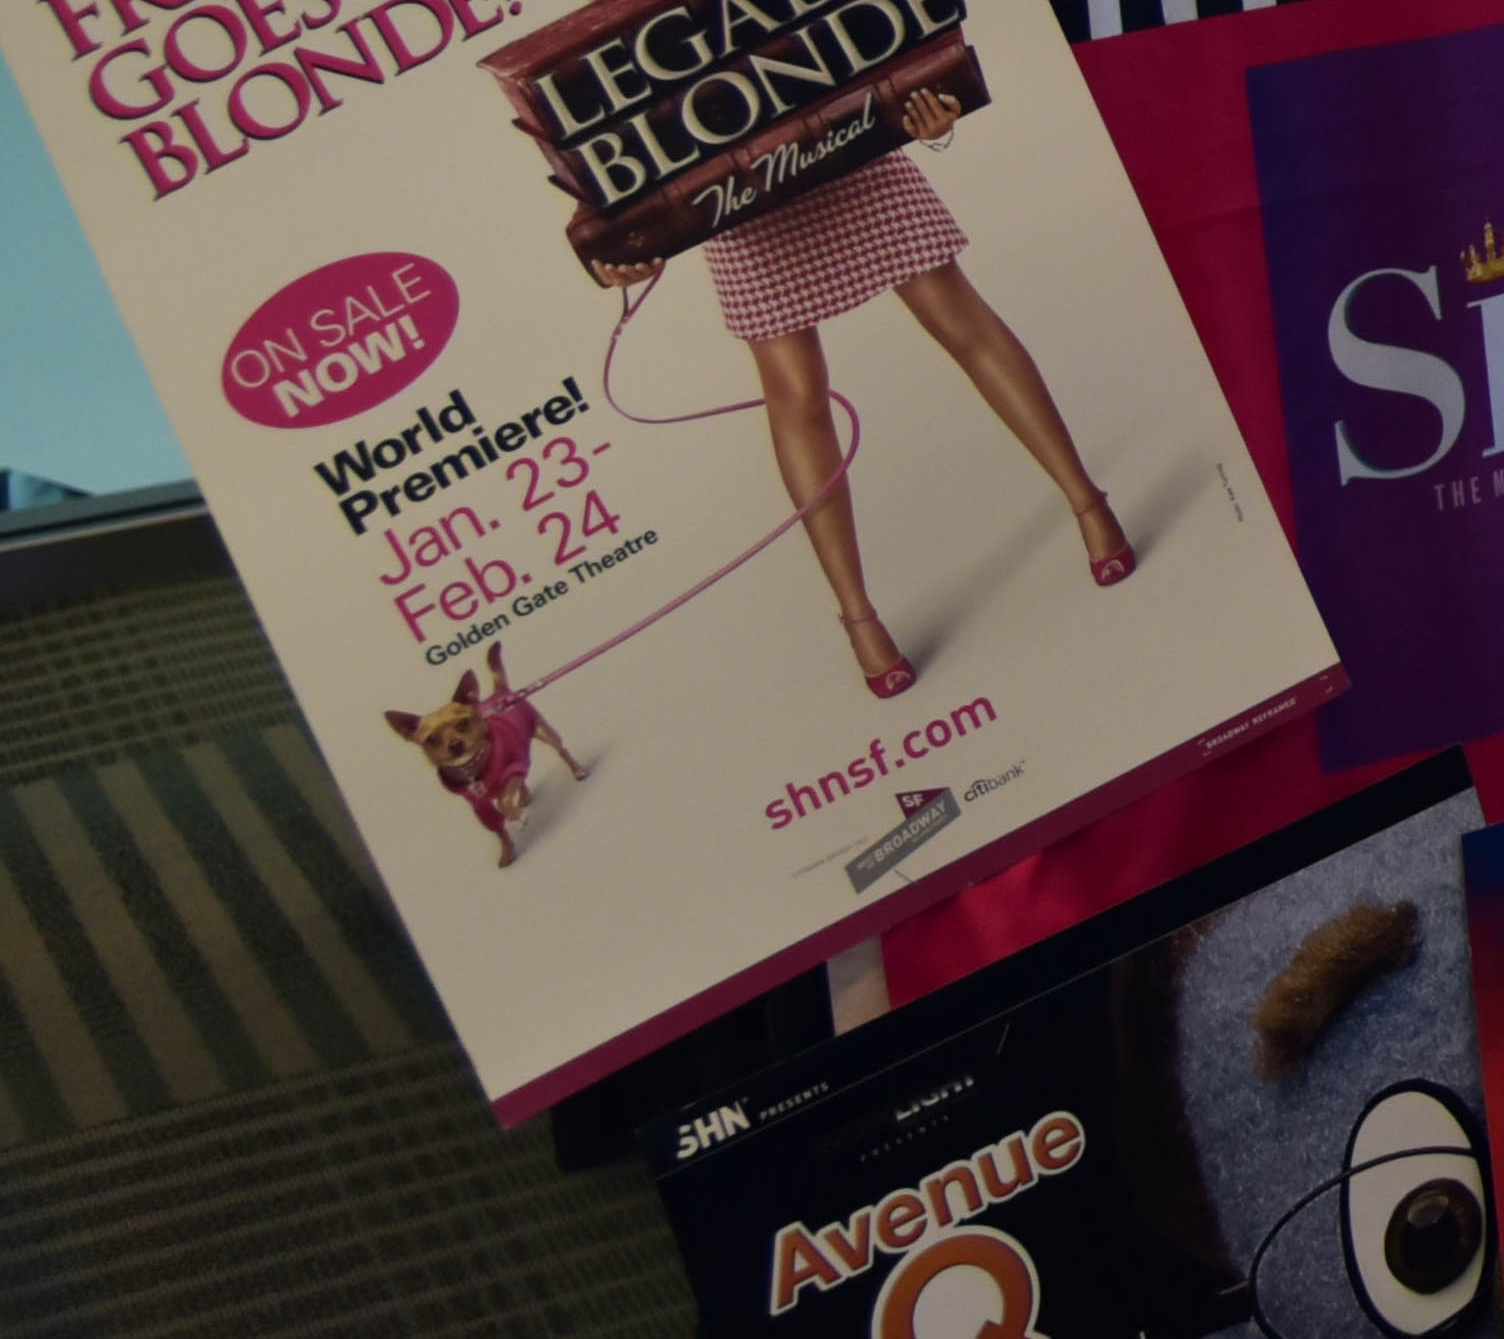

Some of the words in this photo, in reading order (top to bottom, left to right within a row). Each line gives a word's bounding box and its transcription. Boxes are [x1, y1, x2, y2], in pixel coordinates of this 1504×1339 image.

[692, 167, 758, 233] The
[760, 92, 876, 197] Musical
[230, 336, 305, 390] ON
[314, 257, 431, 356] SALE
[273, 322, 427, 419] NOW!
[314, 389, 480, 501] World
[339, 377, 590, 537] Premiere!
[1435, 478, 1482, 513] THE
[378, 496, 501, 588] Jan.
[506, 438, 614, 515] 23-
[392, 562, 534, 646] Feb.
[539, 490, 621, 569] 24
[425, 607, 509, 670] Golden
[511, 576, 569, 626] Gate
[567, 527, 659, 595] Theatre
[764, 696, 998, 830] shnsf.com
[759, 1081, 829, 1121] PRESENTS
[769, 1110, 1086, 1316] Avenue
[872, 1225, 1051, 1339] Q
